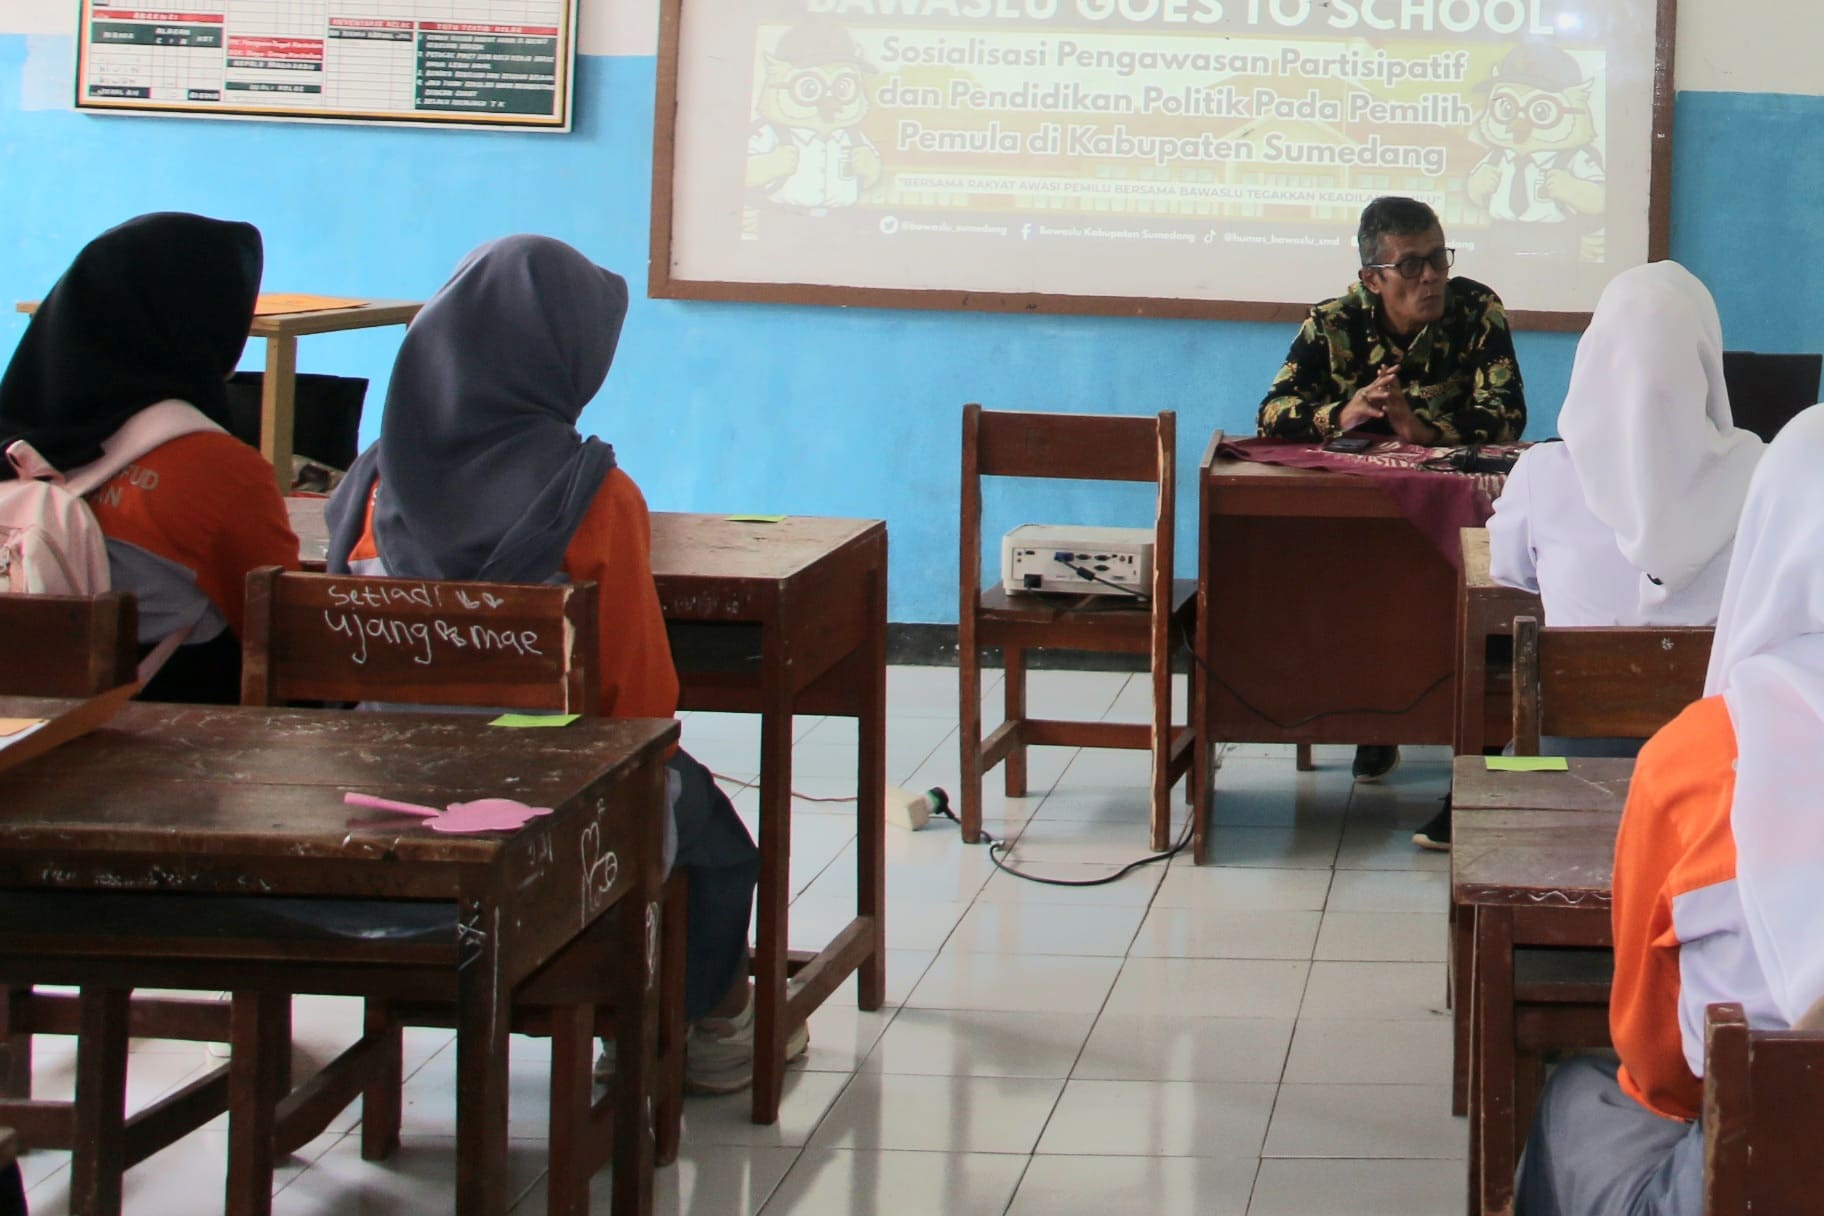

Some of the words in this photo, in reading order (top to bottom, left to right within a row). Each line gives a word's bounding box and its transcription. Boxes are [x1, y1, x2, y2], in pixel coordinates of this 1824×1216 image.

[880, 35, 1048, 67] Sosialisasi
[1056, 40, 1272, 77] Pengawasan
[1279, 47, 1469, 87] Partisipatif
[878, 77, 941, 107] dan
[950, 78, 1133, 112] Pendidikan
[1142, 85, 1251, 120] Politik
[1254, 88, 1340, 121] Pada
[1348, 92, 1473, 125] Pemilih
[897, 120, 1021, 154] Pemula
[1028, 124, 1060, 154] di
[1068, 125, 1254, 166] Kabupaten
[1263, 133, 1446, 175] Sumedang
[968, 178, 1015, 191] RAKYAT
[1019, 180, 1061, 192] AWASI
[1115, 184, 1176, 195] BERSAMA
[1180, 187, 1243, 198] BAWASLU
[1247, 189, 1315, 200] TEGAKKAN
[1318, 191, 1376, 203] KEADILA
[1084, 226, 1140, 240] Kabupaten
[1141, 228, 1196, 243] Sumedang
